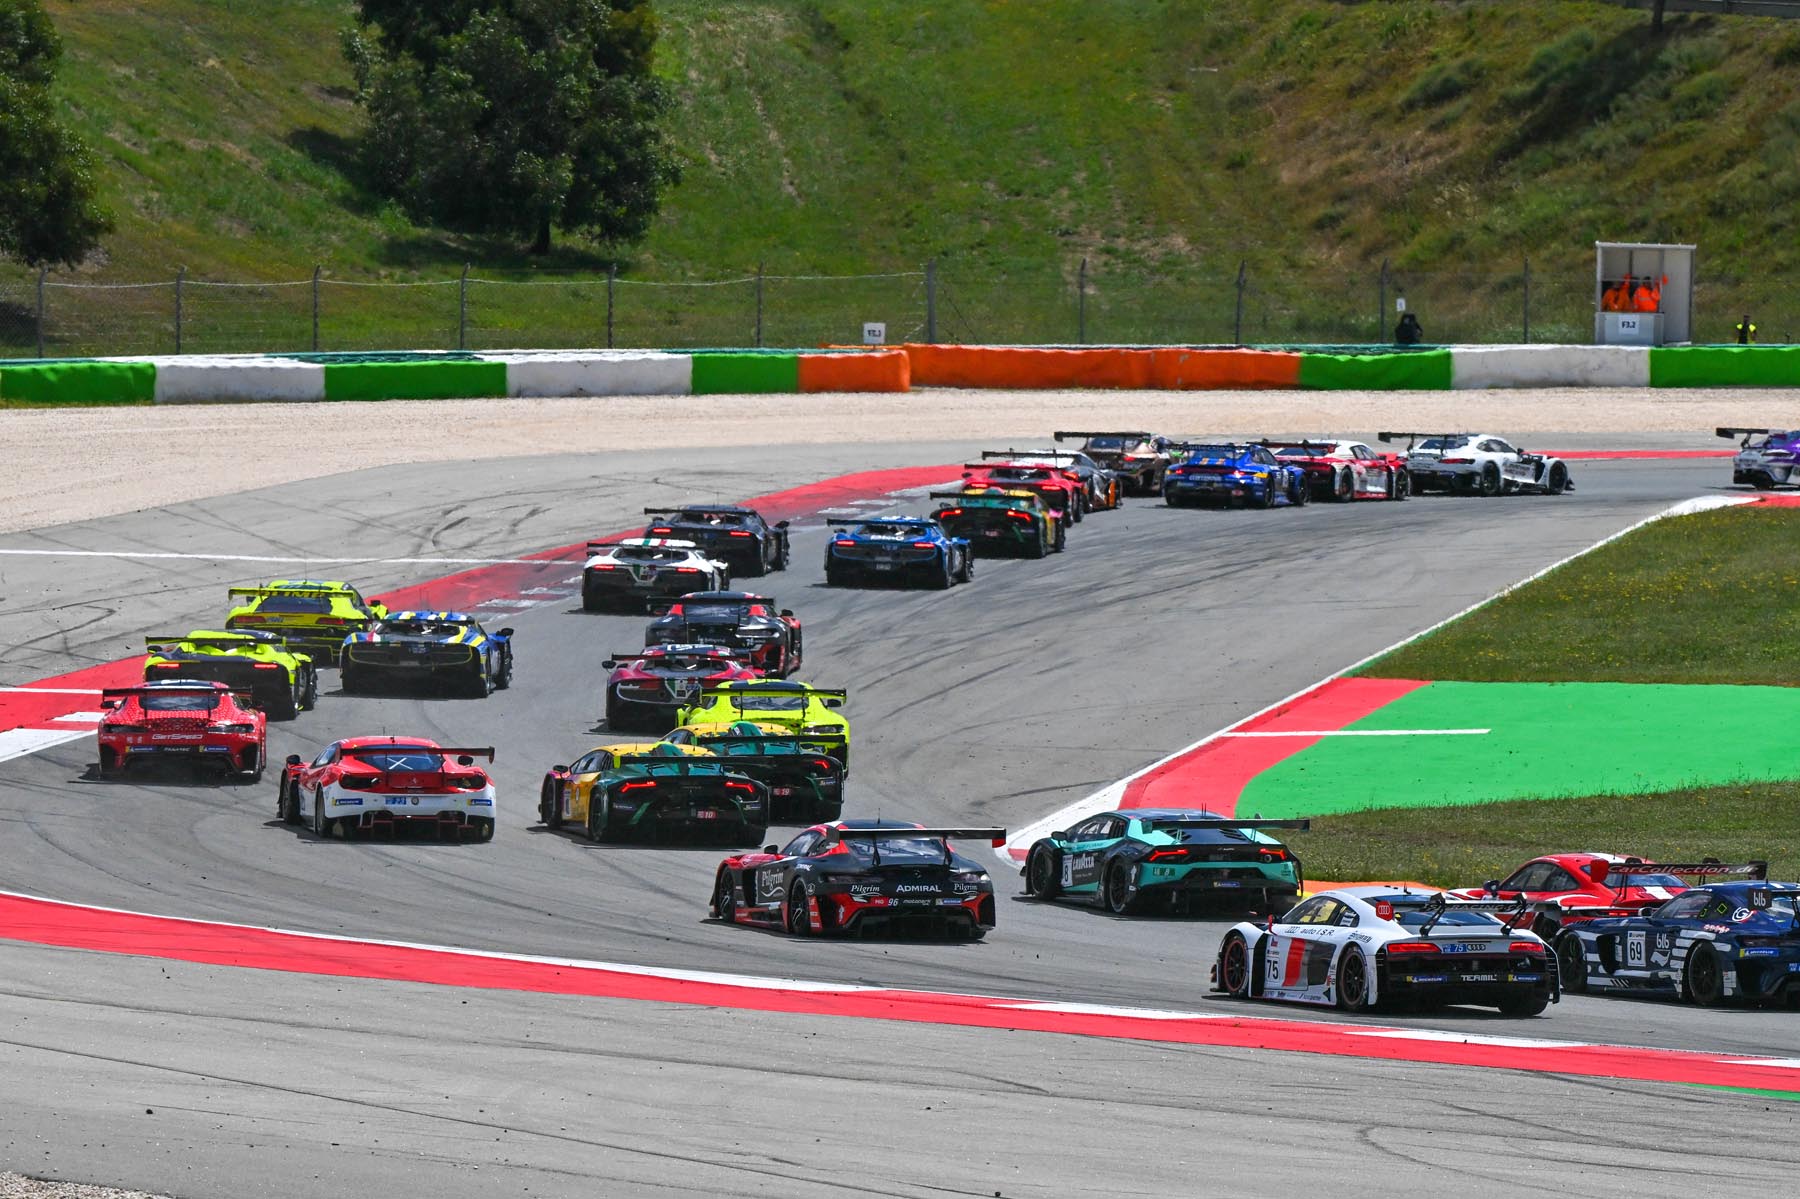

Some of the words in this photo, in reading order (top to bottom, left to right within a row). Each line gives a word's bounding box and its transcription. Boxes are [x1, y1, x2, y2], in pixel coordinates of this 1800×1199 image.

[1064, 864, 1069, 882] 8
[851, 884, 880, 894] Pilgrim
[896, 884, 942, 893] ADMIRAL
[954, 883, 978, 892] Pilgrim
[888, 898, 899, 906] 96
[1454, 944, 1464, 952] 75
[1629, 941, 1642, 960] 69
[1266, 959, 1279, 980] 75
